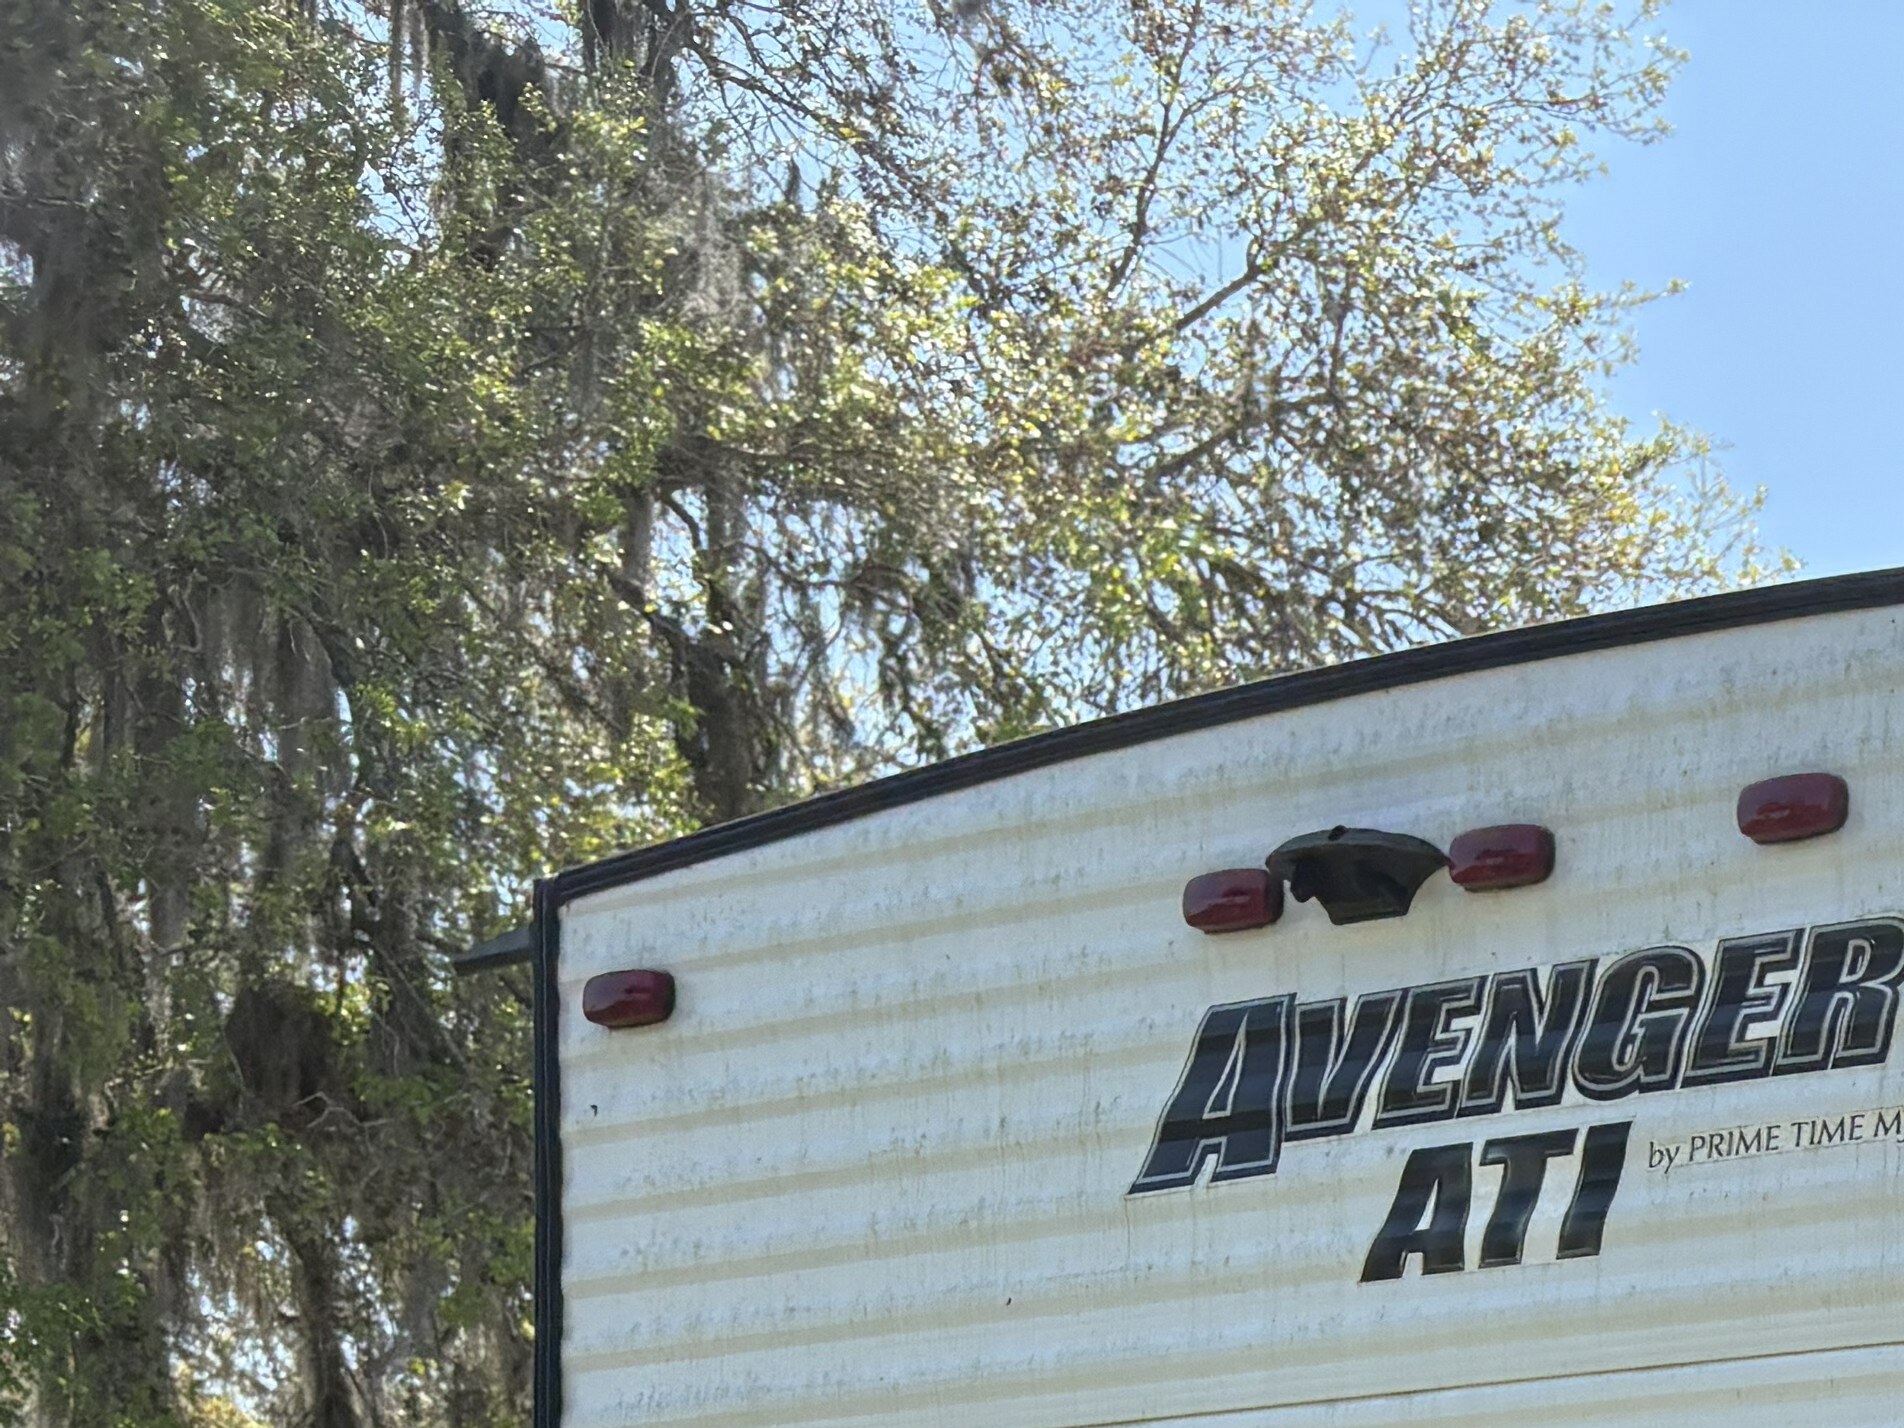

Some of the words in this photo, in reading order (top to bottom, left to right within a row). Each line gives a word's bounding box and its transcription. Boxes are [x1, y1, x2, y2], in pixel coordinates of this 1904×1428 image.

[1649, 1141, 1681, 1174] by
[1688, 1124, 1781, 1162] PRIME
[1791, 1113, 1865, 1148] TIME
[1359, 1120, 1637, 1284] ATI
